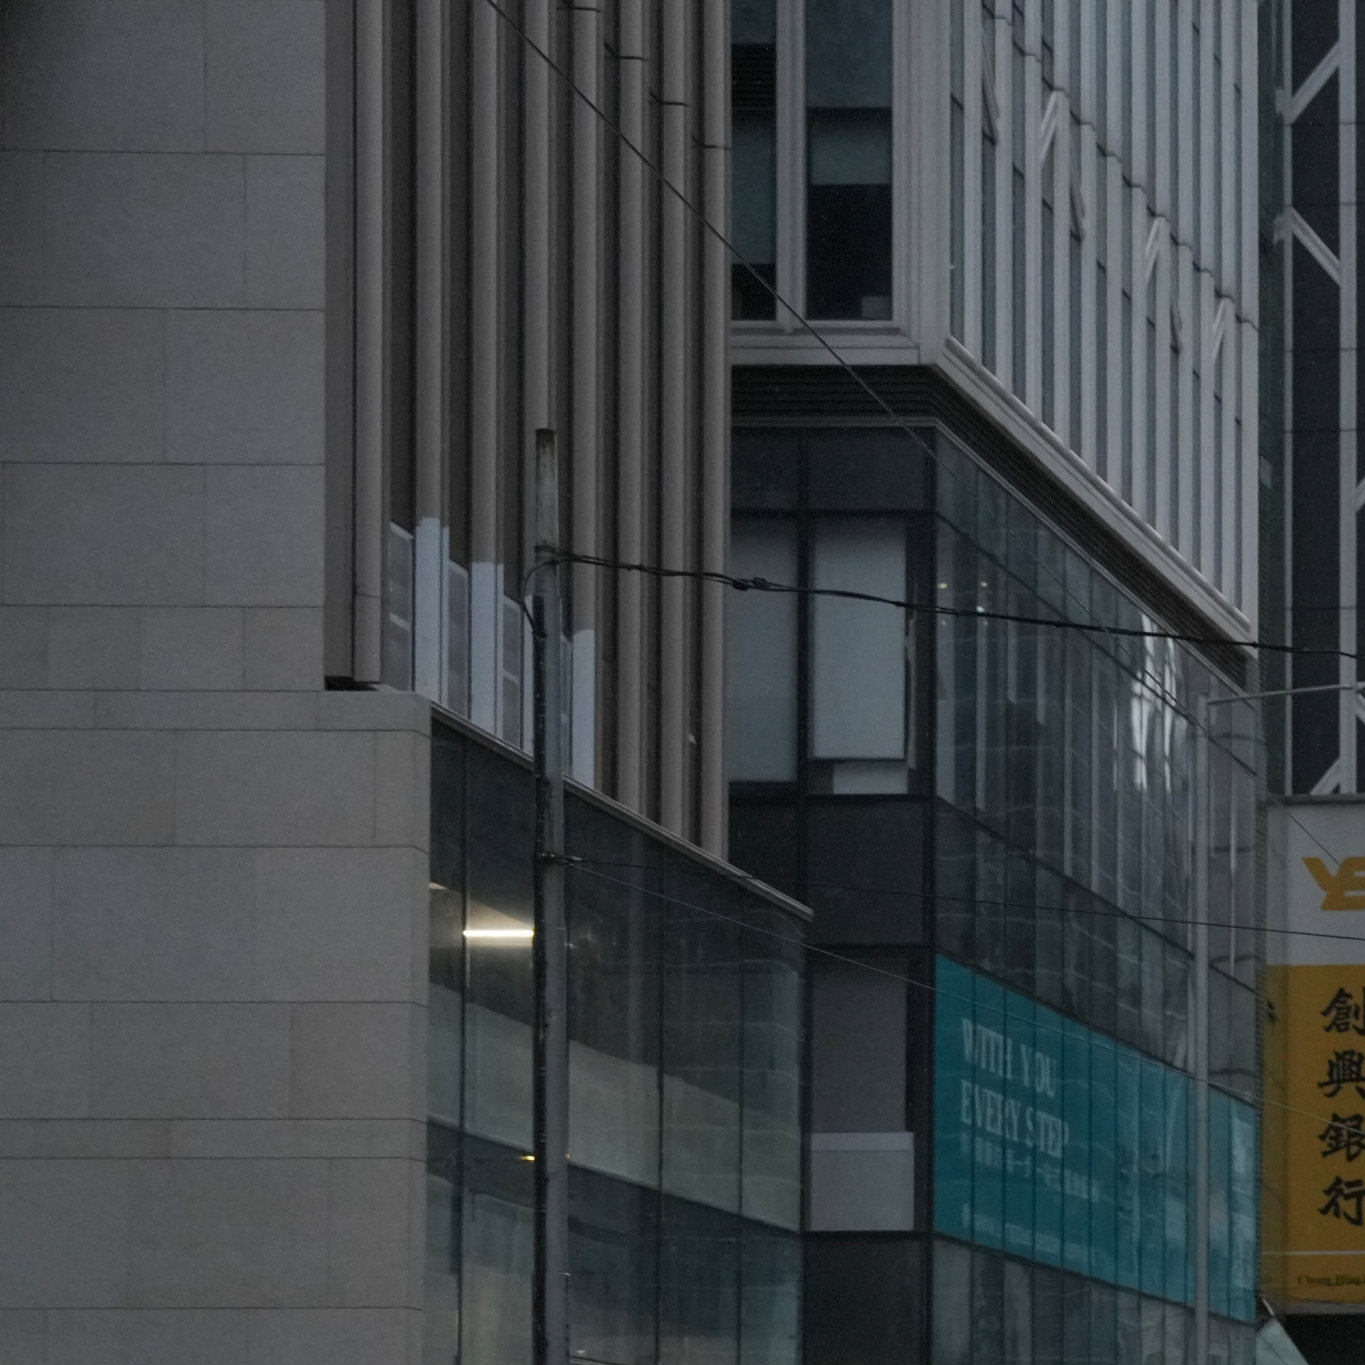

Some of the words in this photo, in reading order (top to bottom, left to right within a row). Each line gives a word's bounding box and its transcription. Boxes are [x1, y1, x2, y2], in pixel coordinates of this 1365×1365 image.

[961, 1018, 1013, 1080] WITH
[1020, 1044, 1057, 1098] YOU
[961, 1079, 1021, 1142] EVERY
[1026, 1106, 1069, 1159] STEP
